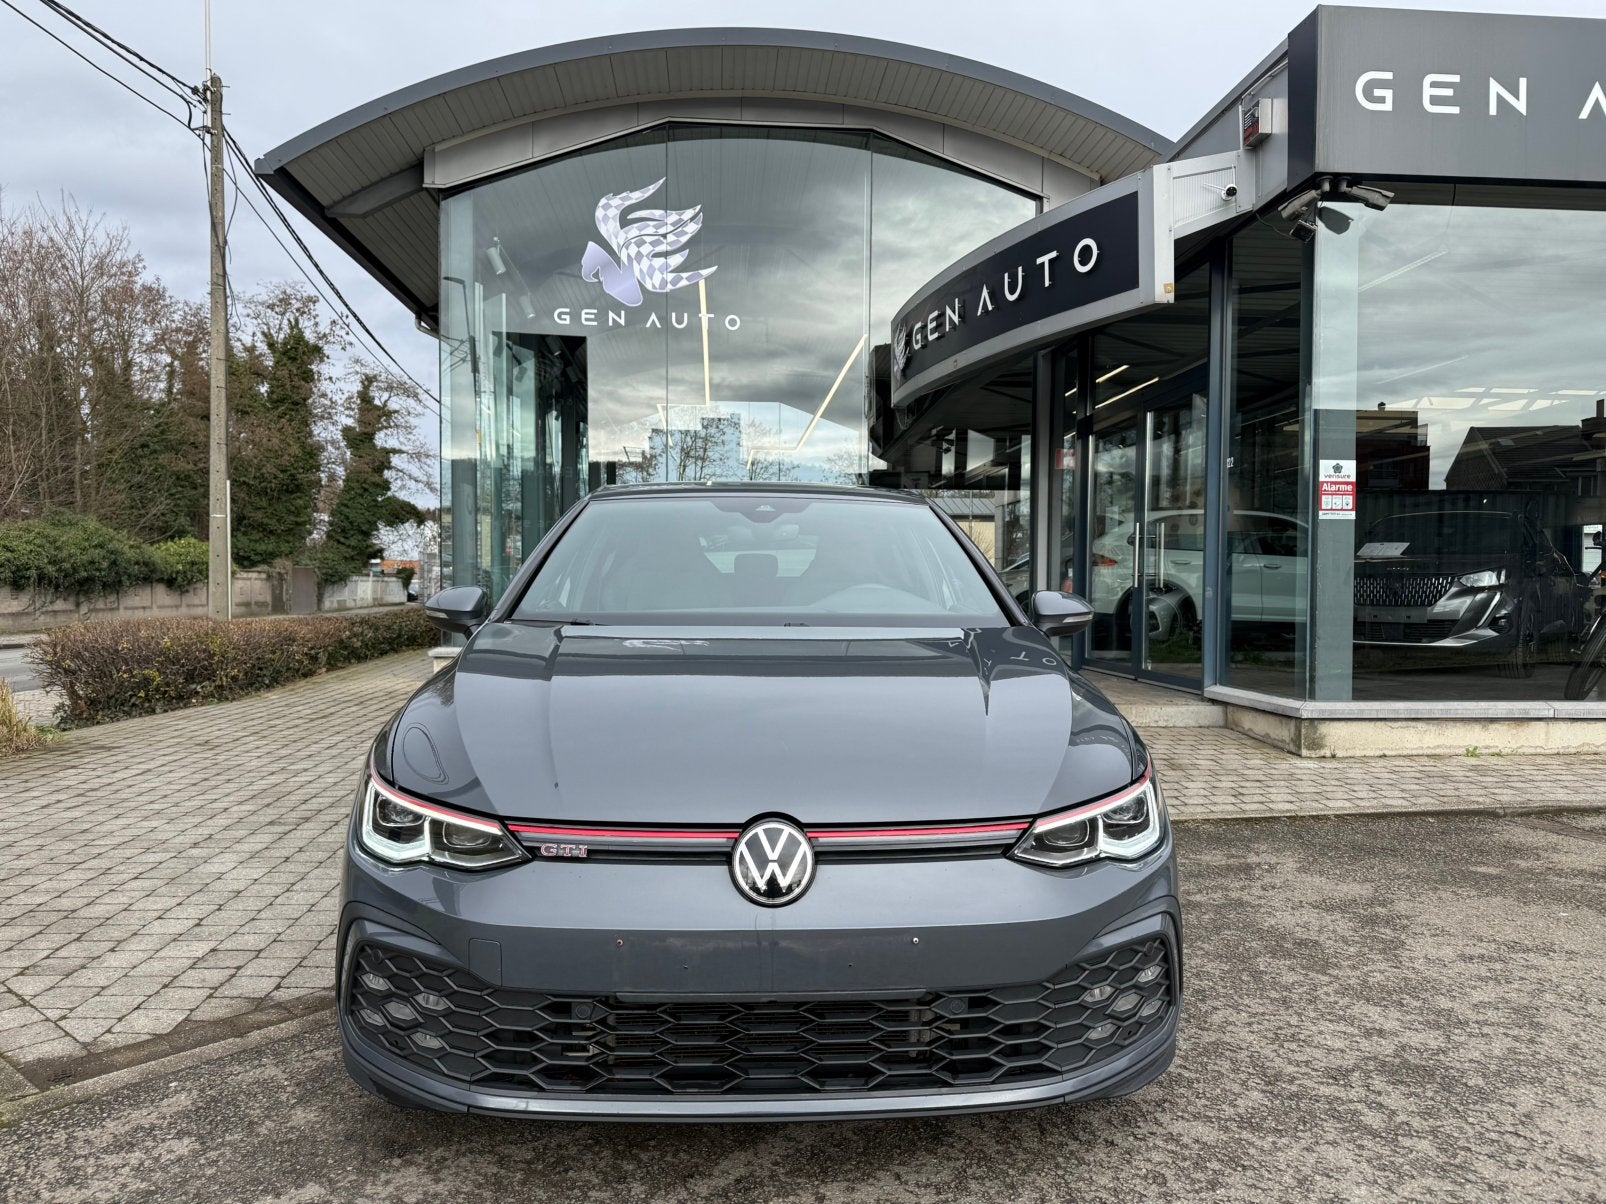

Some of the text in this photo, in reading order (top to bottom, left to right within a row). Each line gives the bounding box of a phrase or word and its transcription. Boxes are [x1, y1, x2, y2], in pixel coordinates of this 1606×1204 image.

[1355, 70, 1527, 116] GEN
[912, 237, 1098, 350] GEN AUTO
[553, 307, 741, 331] GEN AUTO
[1322, 482, 1353, 491] Alarme
[540, 843, 588, 858] GTI
